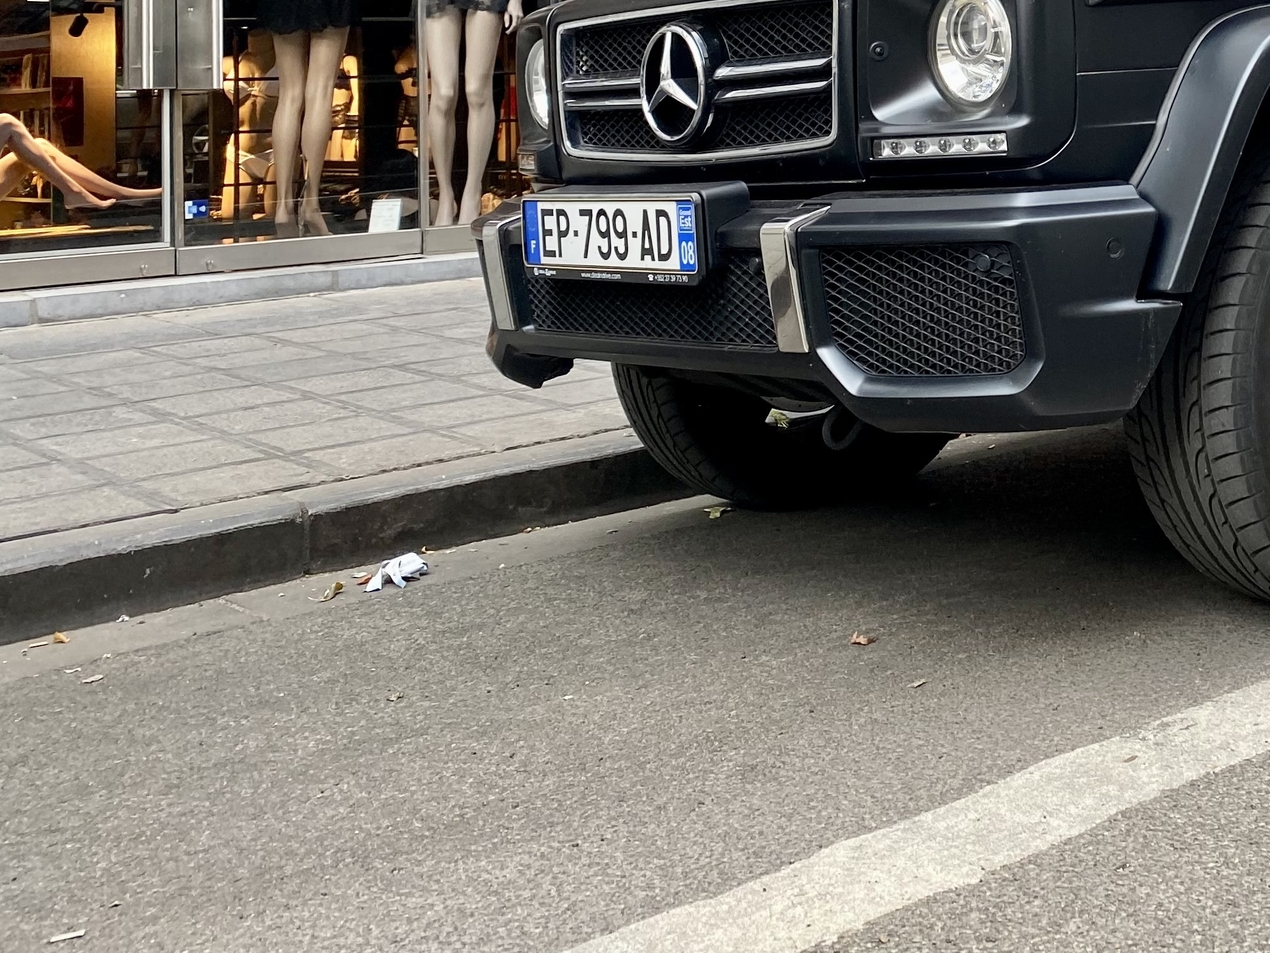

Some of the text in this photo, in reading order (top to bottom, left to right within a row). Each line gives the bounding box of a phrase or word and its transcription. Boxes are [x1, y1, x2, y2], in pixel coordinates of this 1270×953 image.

[679, 216, 692, 227] Est
[540, 208, 673, 262] EP-799-AD
[530, 240, 537, 254] F
[681, 241, 695, 265] 08
